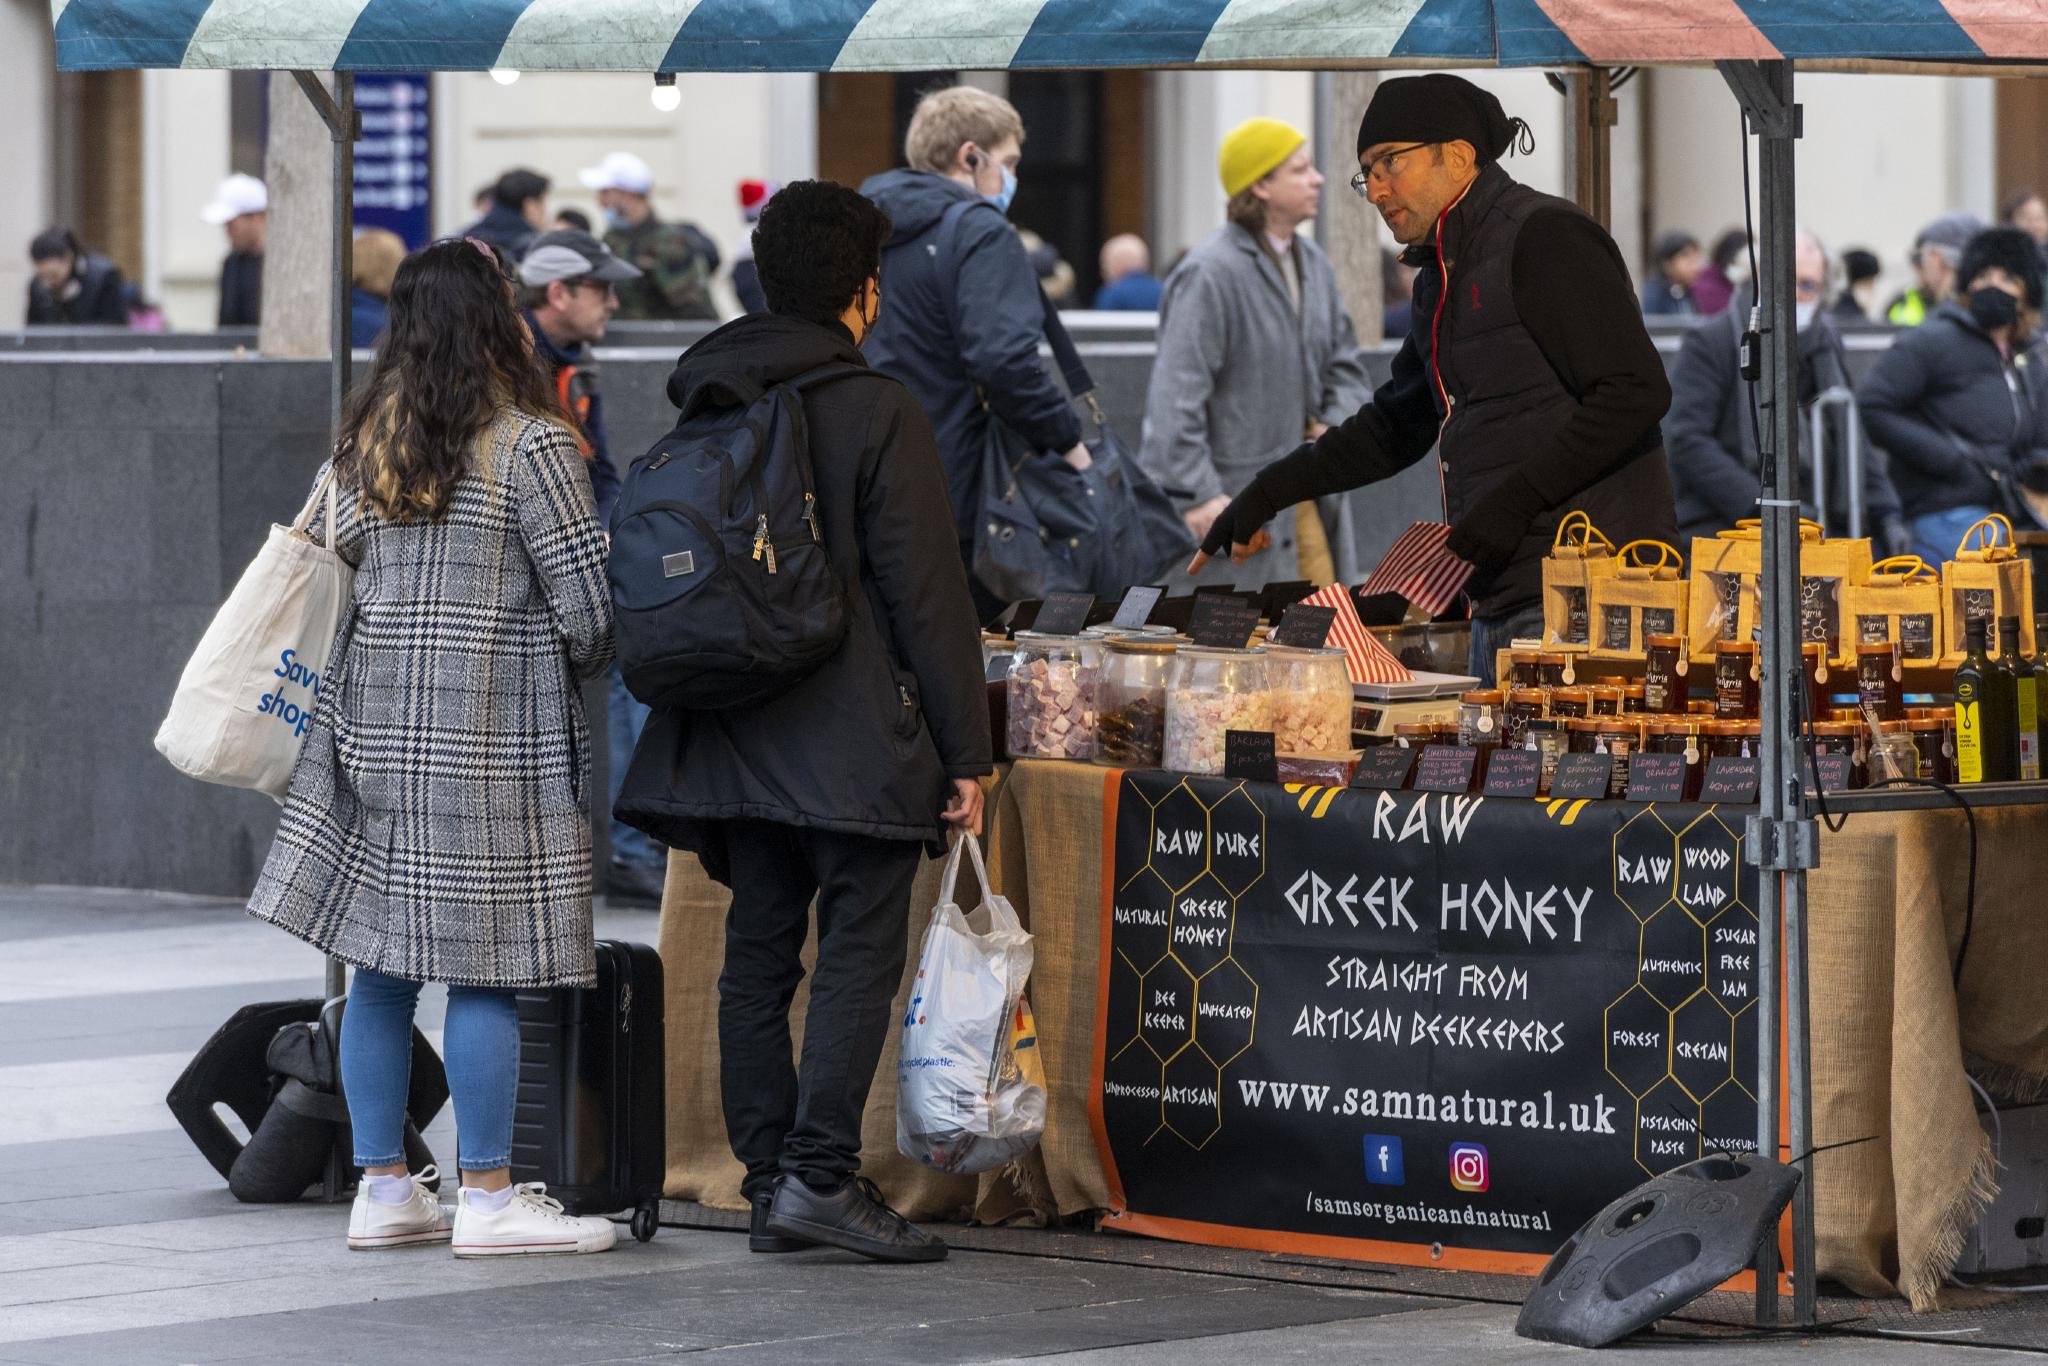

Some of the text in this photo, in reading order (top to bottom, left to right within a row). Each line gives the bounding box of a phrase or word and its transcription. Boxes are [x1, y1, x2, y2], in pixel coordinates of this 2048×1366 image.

[1425, 748, 1454, 757] LIMITED
[1491, 766, 1510, 774] WILD
[1635, 758, 1661, 768] LEMON
[1716, 764, 1756, 775] LAVENDER
[1646, 768, 1680, 778] ORANGE
[1372, 790, 1484, 845] RAW
[1156, 827, 1260, 858] RAW PURE
[1684, 847, 1730, 870] WOOD
[1618, 854, 1672, 885] RAW
[1683, 882, 1727, 909] LAND
[1115, 905, 1168, 926] NATURAL
[1179, 897, 1228, 919] GREEK
[1283, 868, 1594, 944] GREEK HONEY
[1174, 924, 1227, 948] HONEY
[1714, 928, 1756, 945] SUGAR
[1641, 958, 1702, 976] AUTHENTIC
[1720, 954, 1750, 971] FREE
[1326, 954, 1528, 1000] STRAIGHT FROM
[1155, 989, 1176, 1007] BEE
[1722, 980, 1748, 998] JAM
[1198, 1001, 1253, 1020] UNHEATED
[1145, 1012, 1185, 1031] KEEPER
[1292, 1004, 1565, 1054] ARTISAN BEEKEEPERS
[1613, 1030, 1660, 1048] FOREST
[1676, 1041, 1727, 1063] CRETAN
[1104, 1080, 1160, 1099] UNPROCESSED
[1162, 1085, 1217, 1109] ARTISAN
[1238, 1078, 1617, 1134] www.samnatural.uk
[1640, 1115, 1698, 1133] PISTACHIO
[1651, 1139, 1685, 1156] PASTE
[1306, 1190, 1552, 1232] /samsorganicandnatural
